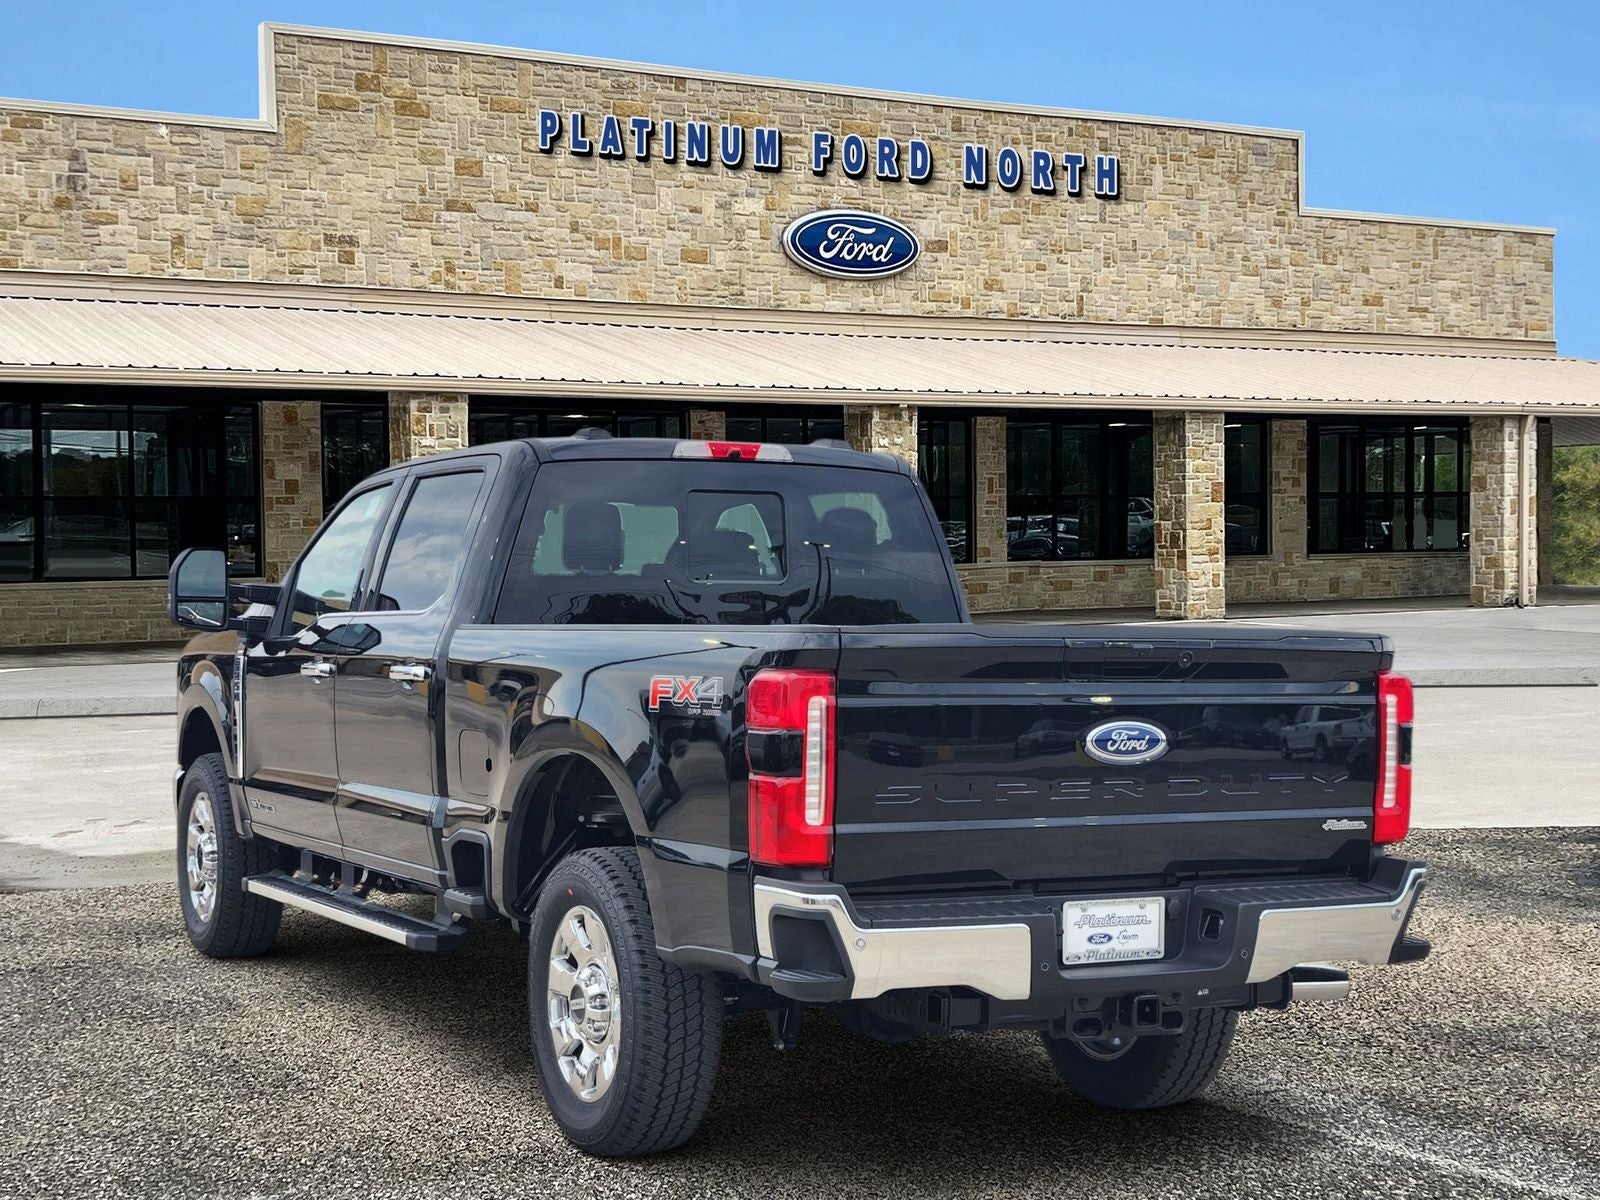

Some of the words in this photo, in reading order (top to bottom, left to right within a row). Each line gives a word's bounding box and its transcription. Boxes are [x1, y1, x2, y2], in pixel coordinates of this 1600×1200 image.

[538, 109, 781, 171] PLATINUM
[812, 131, 933, 182] FORD
[963, 143, 1121, 197] NORTH
[818, 222, 895, 265] Ford
[648, 674, 724, 712] FX4
[1107, 729, 1150, 752] Ford
[875, 777, 1145, 805] SUPER
[1168, 771, 1348, 797] DUTY
[1322, 819, 1368, 831] Platinum
[1073, 912, 1152, 928] Platinum
[1091, 933, 1110, 944] Ford
[1121, 932, 1139, 940] North
[1086, 947, 1142, 961] Platinum
